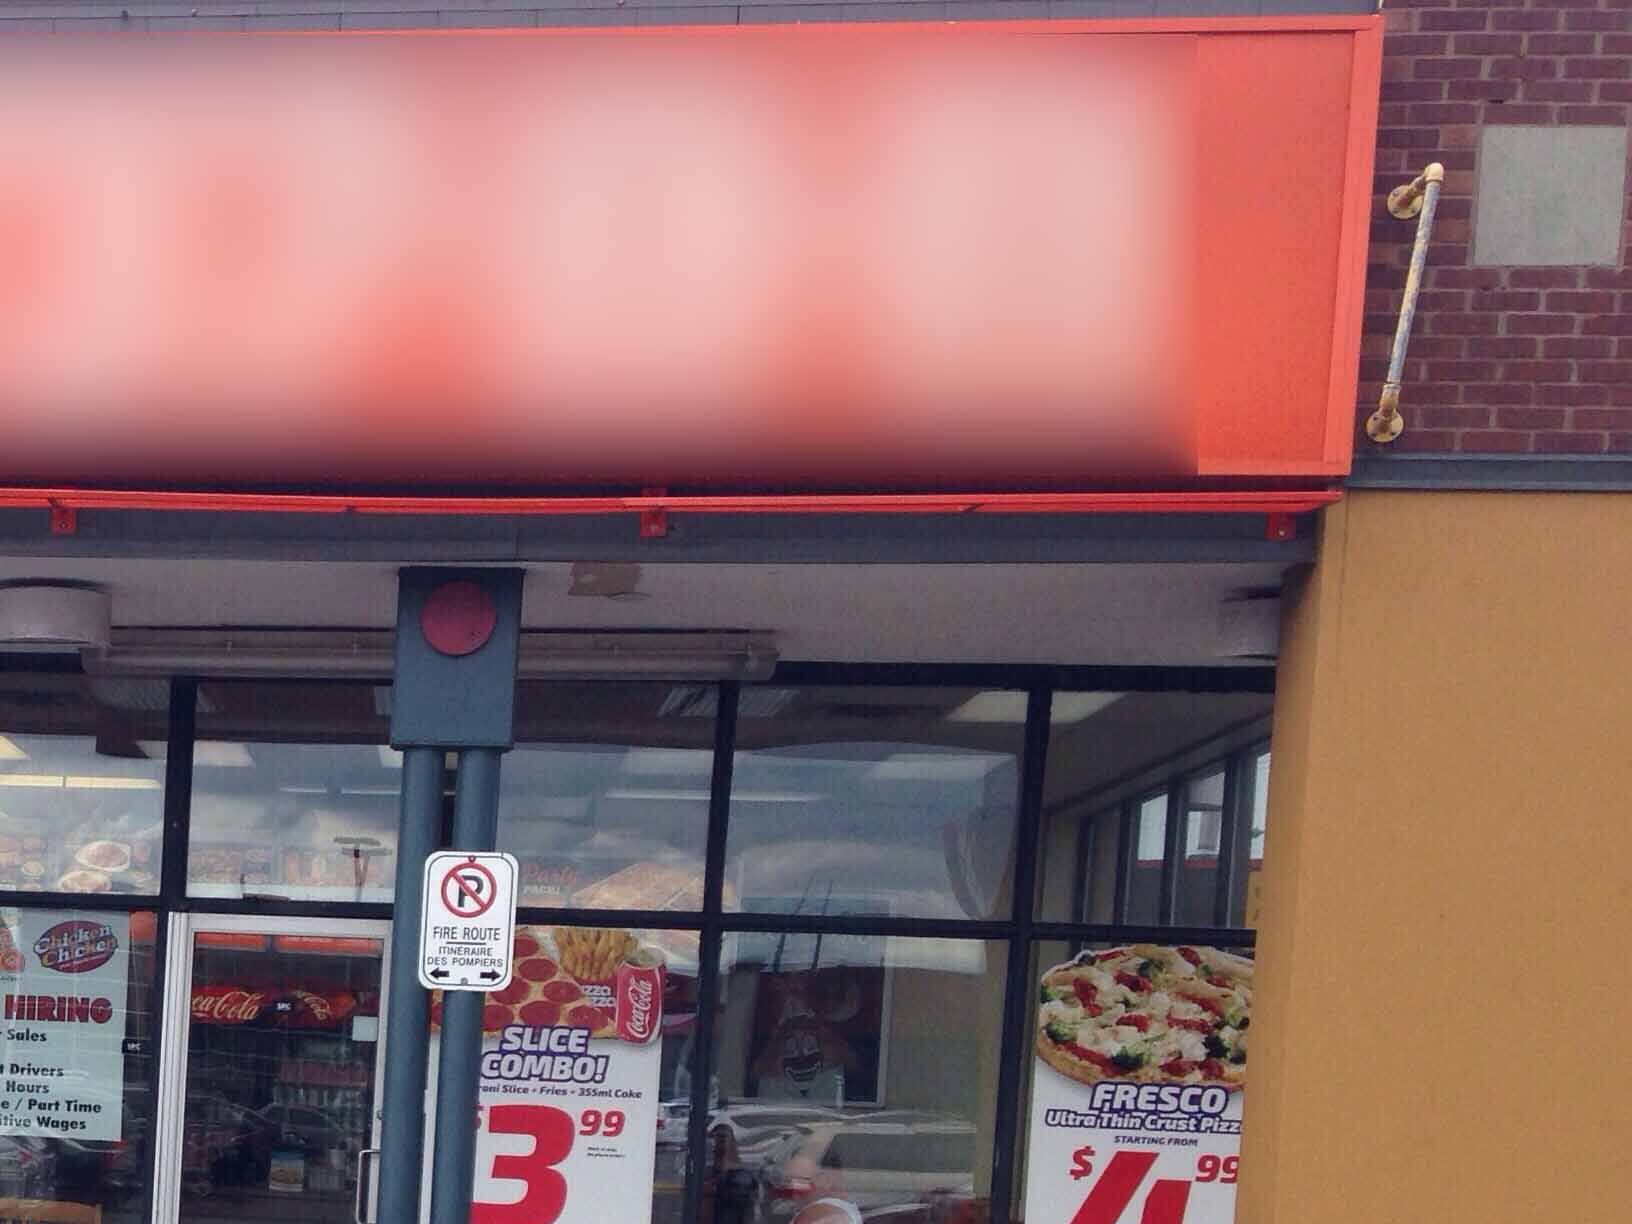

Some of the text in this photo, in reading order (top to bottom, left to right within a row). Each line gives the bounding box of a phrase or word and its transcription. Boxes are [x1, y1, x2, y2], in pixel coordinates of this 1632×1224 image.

[433, 926, 501, 941] FIRE ROUTE
[427, 956, 504, 968] DES POMPIERS
[4, 994, 113, 1024] HIRING
[7, 1028, 47, 1042] Sales
[500, 1026, 589, 1054] SLICE
[9, 1063, 65, 1078] Drivers
[480, 1053, 608, 1083] COMBO!
[5, 1080, 50, 1094] Hours
[502, 1084, 529, 1095] Slice
[539, 1086, 568, 1096] Fries
[614, 1089, 642, 1099] Coke
[27, 1098, 61, 1112] Part
[65, 1100, 102, 1113] Time
[1091, 1083, 1227, 1113] FRESCO
[36, 1115, 86, 1132] Wages
[1047, 1110, 1242, 1133] Ultra Thin Crust Pizz
[1114, 1135, 1198, 1146] STARTING FROM
